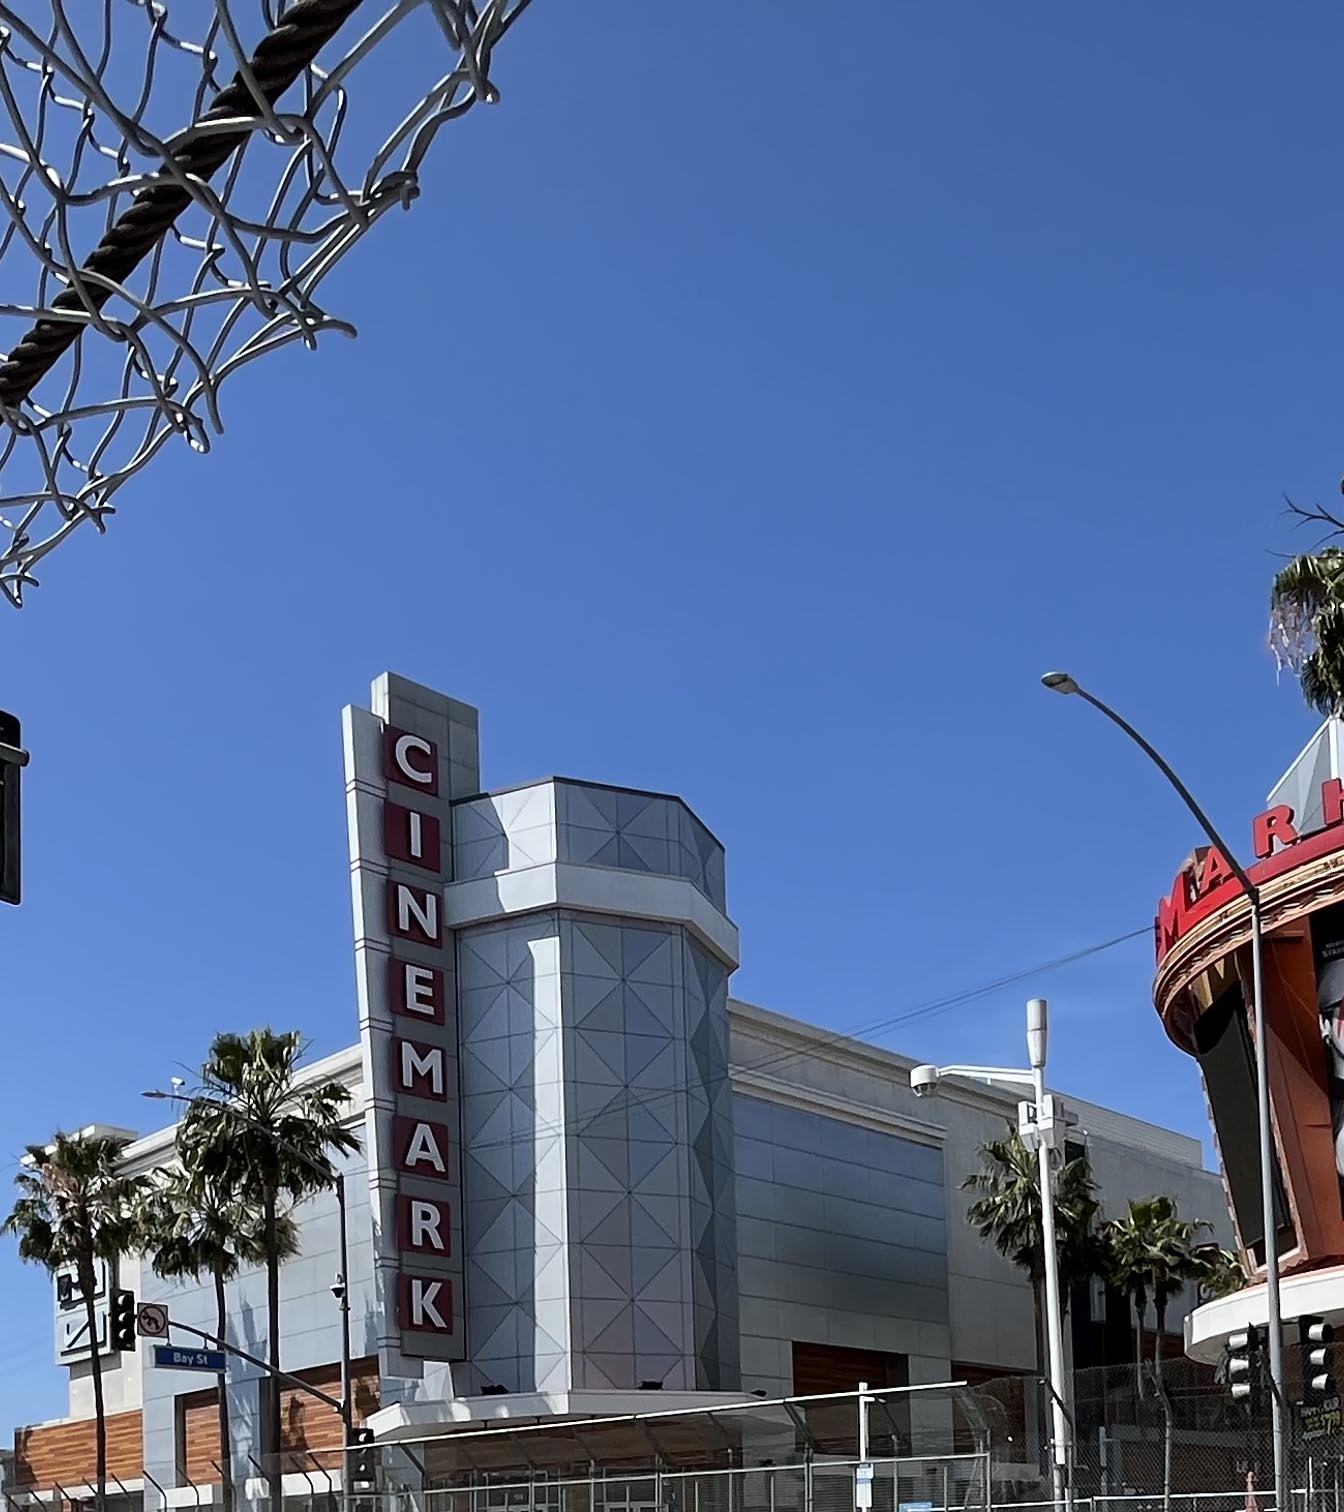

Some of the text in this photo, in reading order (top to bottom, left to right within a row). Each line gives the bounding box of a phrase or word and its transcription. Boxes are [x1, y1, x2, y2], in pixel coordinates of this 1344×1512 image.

[395, 733, 447, 1330] CINEMARK
[173, 1352, 208, 1365] Bay St
